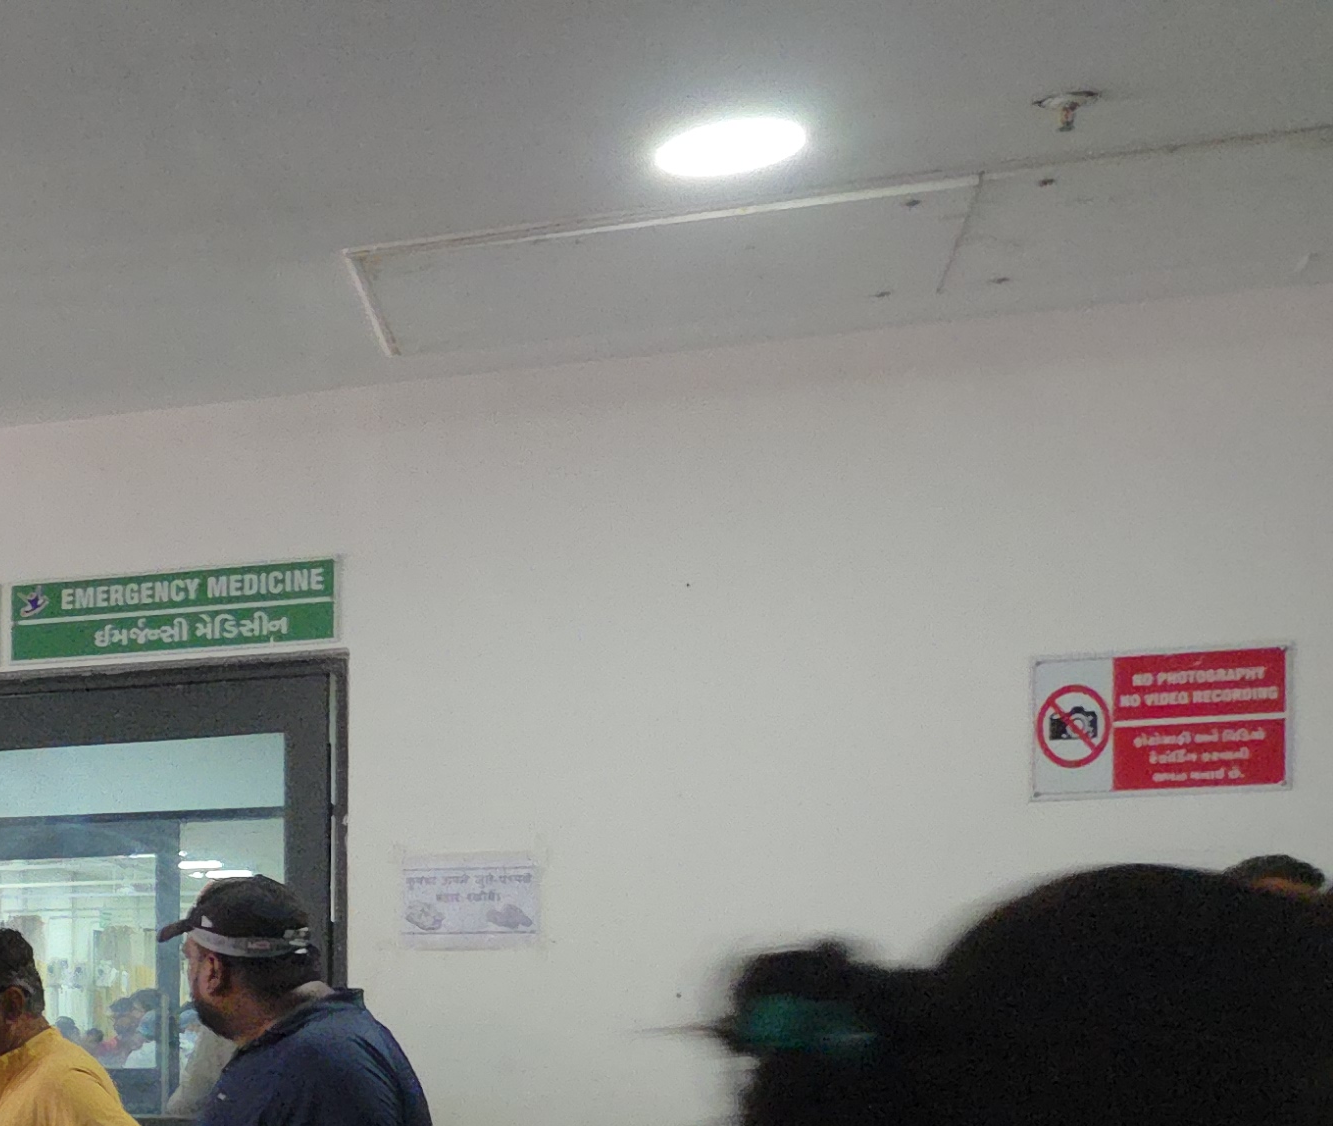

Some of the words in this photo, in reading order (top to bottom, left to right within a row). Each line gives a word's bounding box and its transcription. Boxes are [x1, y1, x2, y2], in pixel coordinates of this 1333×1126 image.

[61, 577, 200, 610] EMERGENCY
[207, 568, 324, 598] MEDICINE
[196, 611, 288, 640] મેડિસીન
[1132, 672, 1152, 686] NO
[1157, 666, 1266, 685] PHOTOGRAPHY
[1119, 694, 1140, 707] NO
[1144, 690, 1189, 706] VIDEO
[1192, 687, 1278, 704] RECORDING
